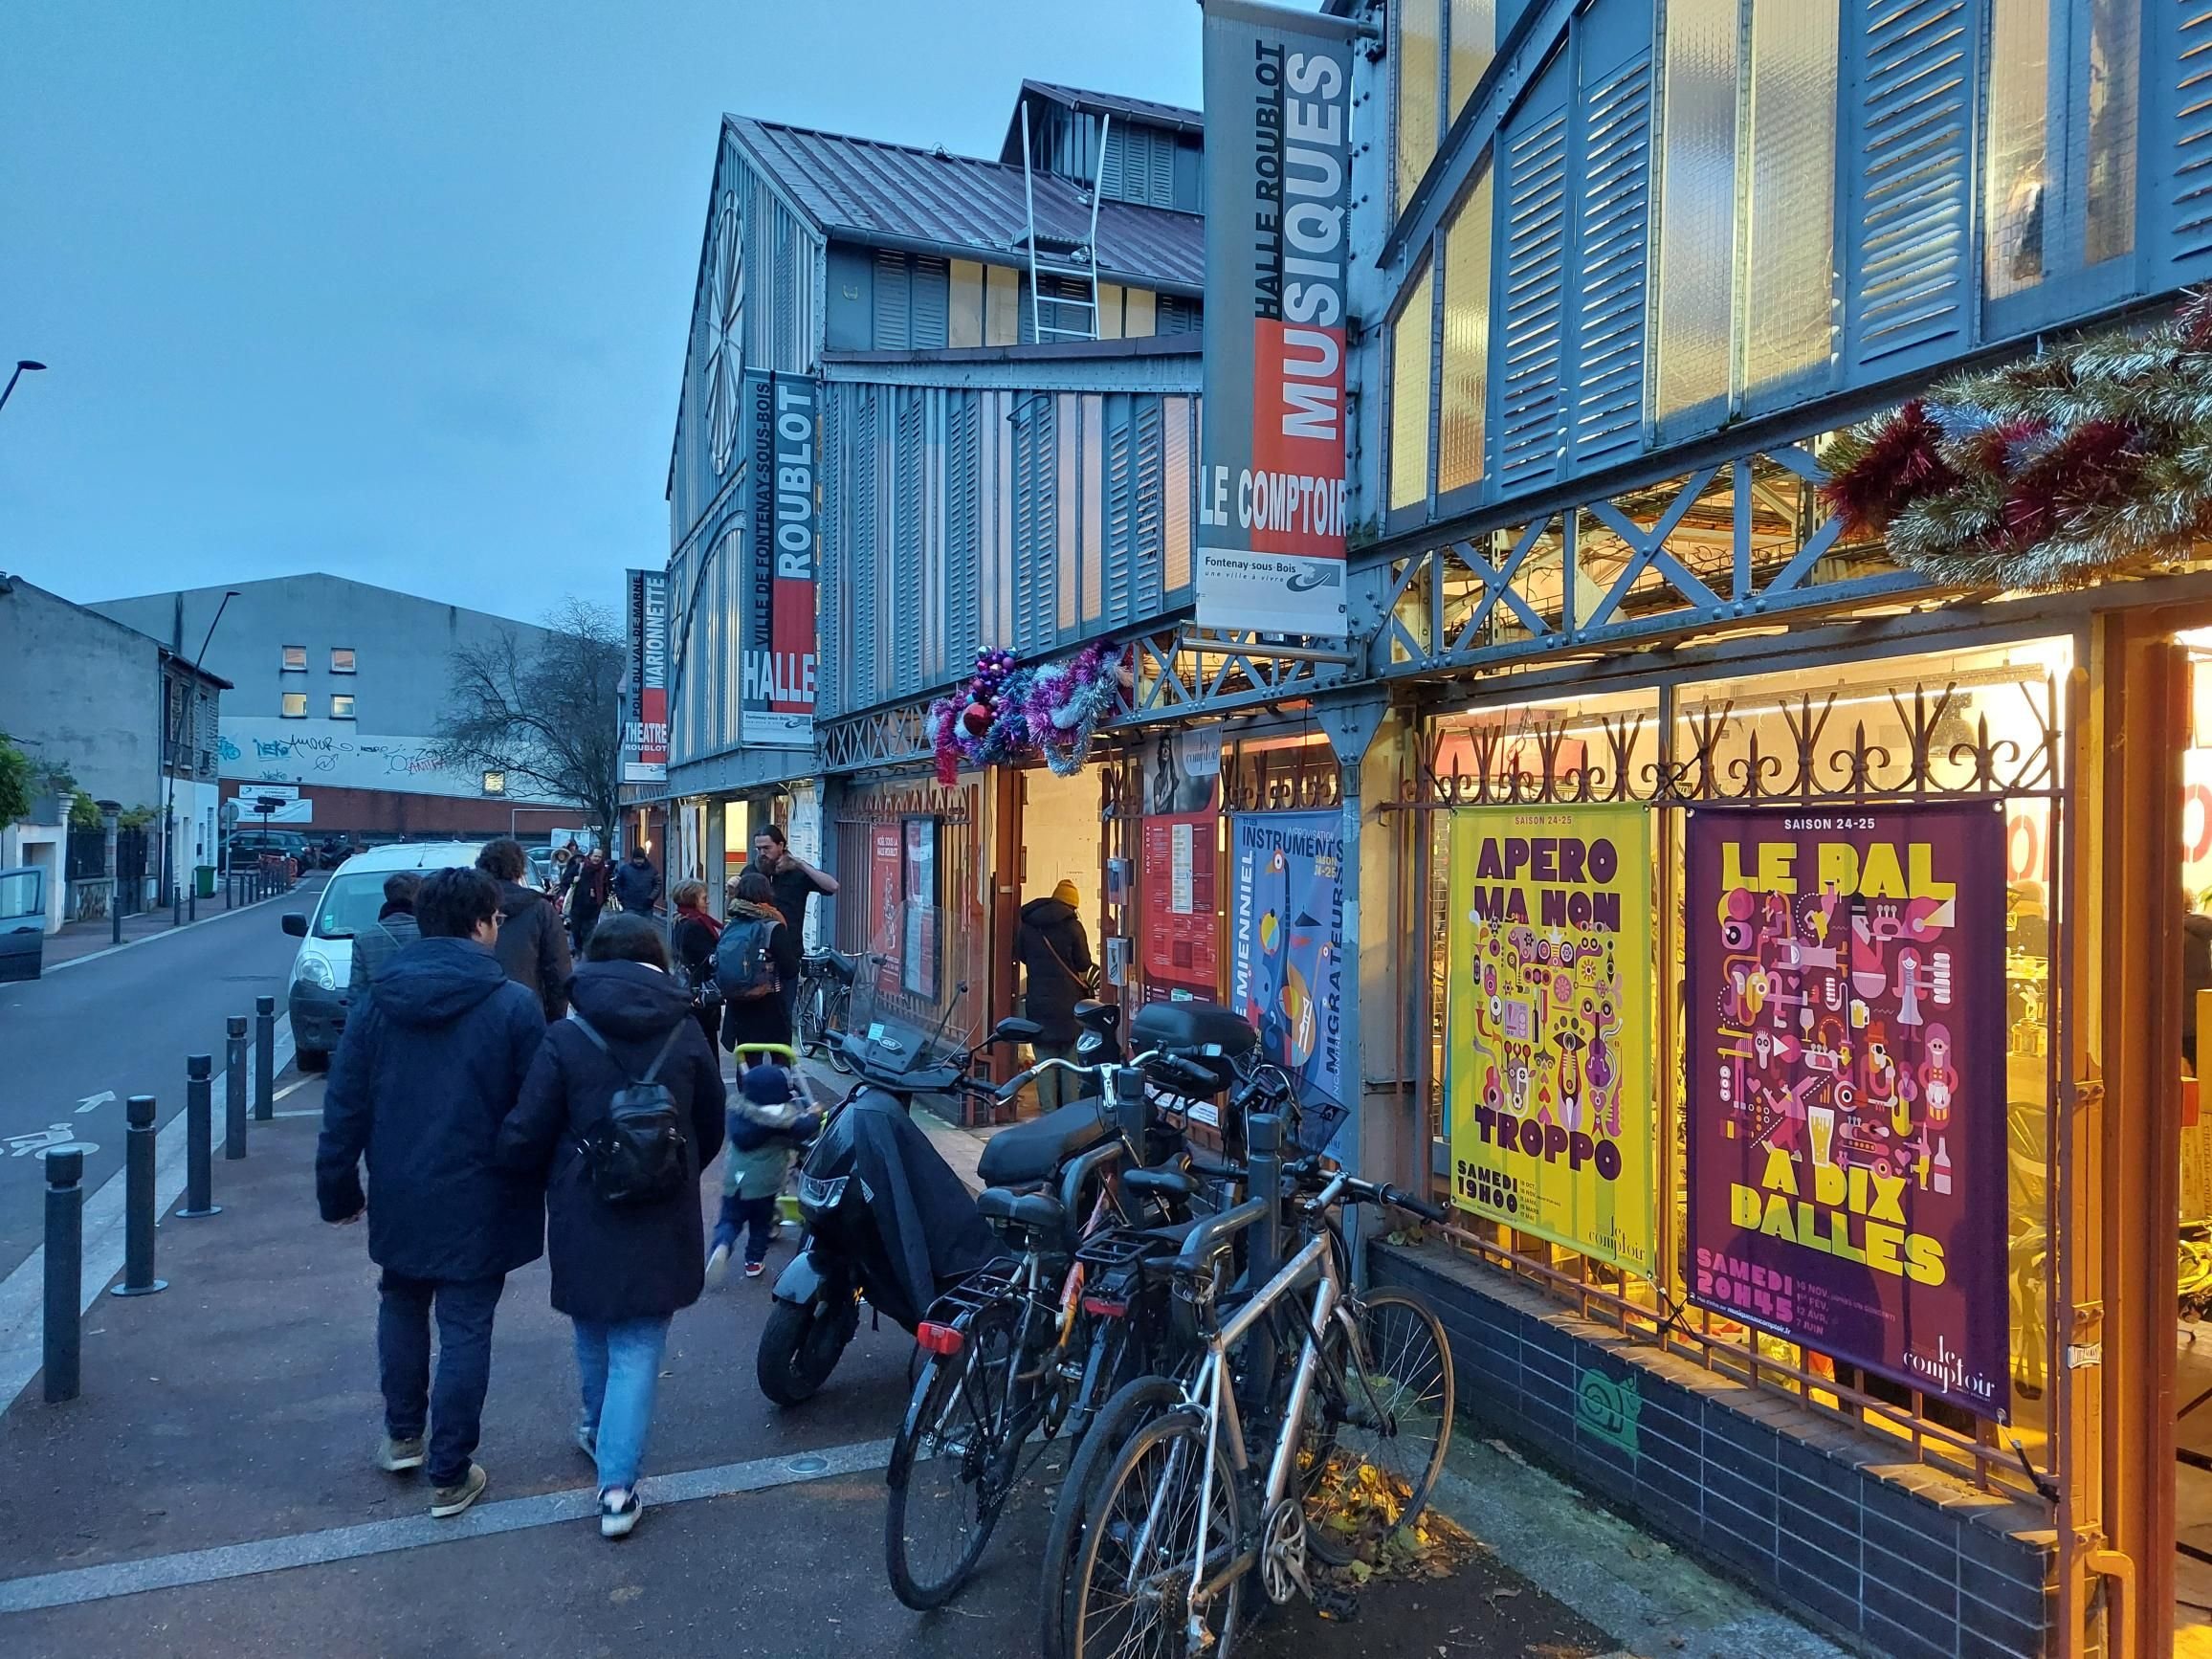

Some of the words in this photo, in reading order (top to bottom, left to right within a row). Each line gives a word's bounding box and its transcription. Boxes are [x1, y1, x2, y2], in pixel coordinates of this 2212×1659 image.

[1256, 39, 1283, 200] ROUBLOT
[1255, 212, 1280, 321] HALLE
[1282, 53, 1345, 441] MUSIQUES
[756, 383, 770, 570] FONTENAY-SOUS-BOIS
[778, 385, 812, 579] ROUBLOT
[1200, 465, 1228, 525] LE
[1238, 469, 1346, 537] COMPTOIR
[756, 573, 769, 595] DE
[632, 575, 642, 662] VAL-DE-MARNE
[645, 577, 665, 689] MARIONNETTE
[756, 599, 770, 646] VILLE
[632, 665, 642, 685] DU
[742, 650, 815, 702] HALLE
[625, 722, 667, 743] THEATRE
[625, 743, 667, 752] ROUBLOT
[1243, 826, 1343, 863] INSTRUMENTS
[1515, 816, 1545, 825] SAISON
[1784, 818, 1831, 830] SAISON
[1836, 818, 1875, 830] 24-25
[1476, 837, 1618, 884] APERO
[1721, 842, 1798, 895] LE
[1818, 842, 1957, 900] BAL
[1236, 850, 1253, 998] MIENNIEL
[1473, 885, 1530, 925] MA
[1541, 889, 1621, 933] NON
[1326, 866, 1343, 1073] MIGRATEURS
[1474, 1104, 1622, 1182] TROPPO
[1457, 1160, 1518, 1194] SAMEDI
[1457, 1176, 1518, 1214] 19H00
[1761, 1148, 1799, 1197] A
[1814, 1162, 1908, 1226] DIX
[1589, 1231, 1646, 1261] comptoir
[1610, 1215, 1622, 1237] le
[1731, 1183, 1947, 1287] BALLES
[1697, 1248, 1793, 1296] SAMEDI
[1697, 1269, 1794, 1323] 20H45
[1803, 1321, 1824, 1336] JUIN
[1938, 1335, 1956, 1364] le
[1903, 1352, 1995, 1398] comptoir
